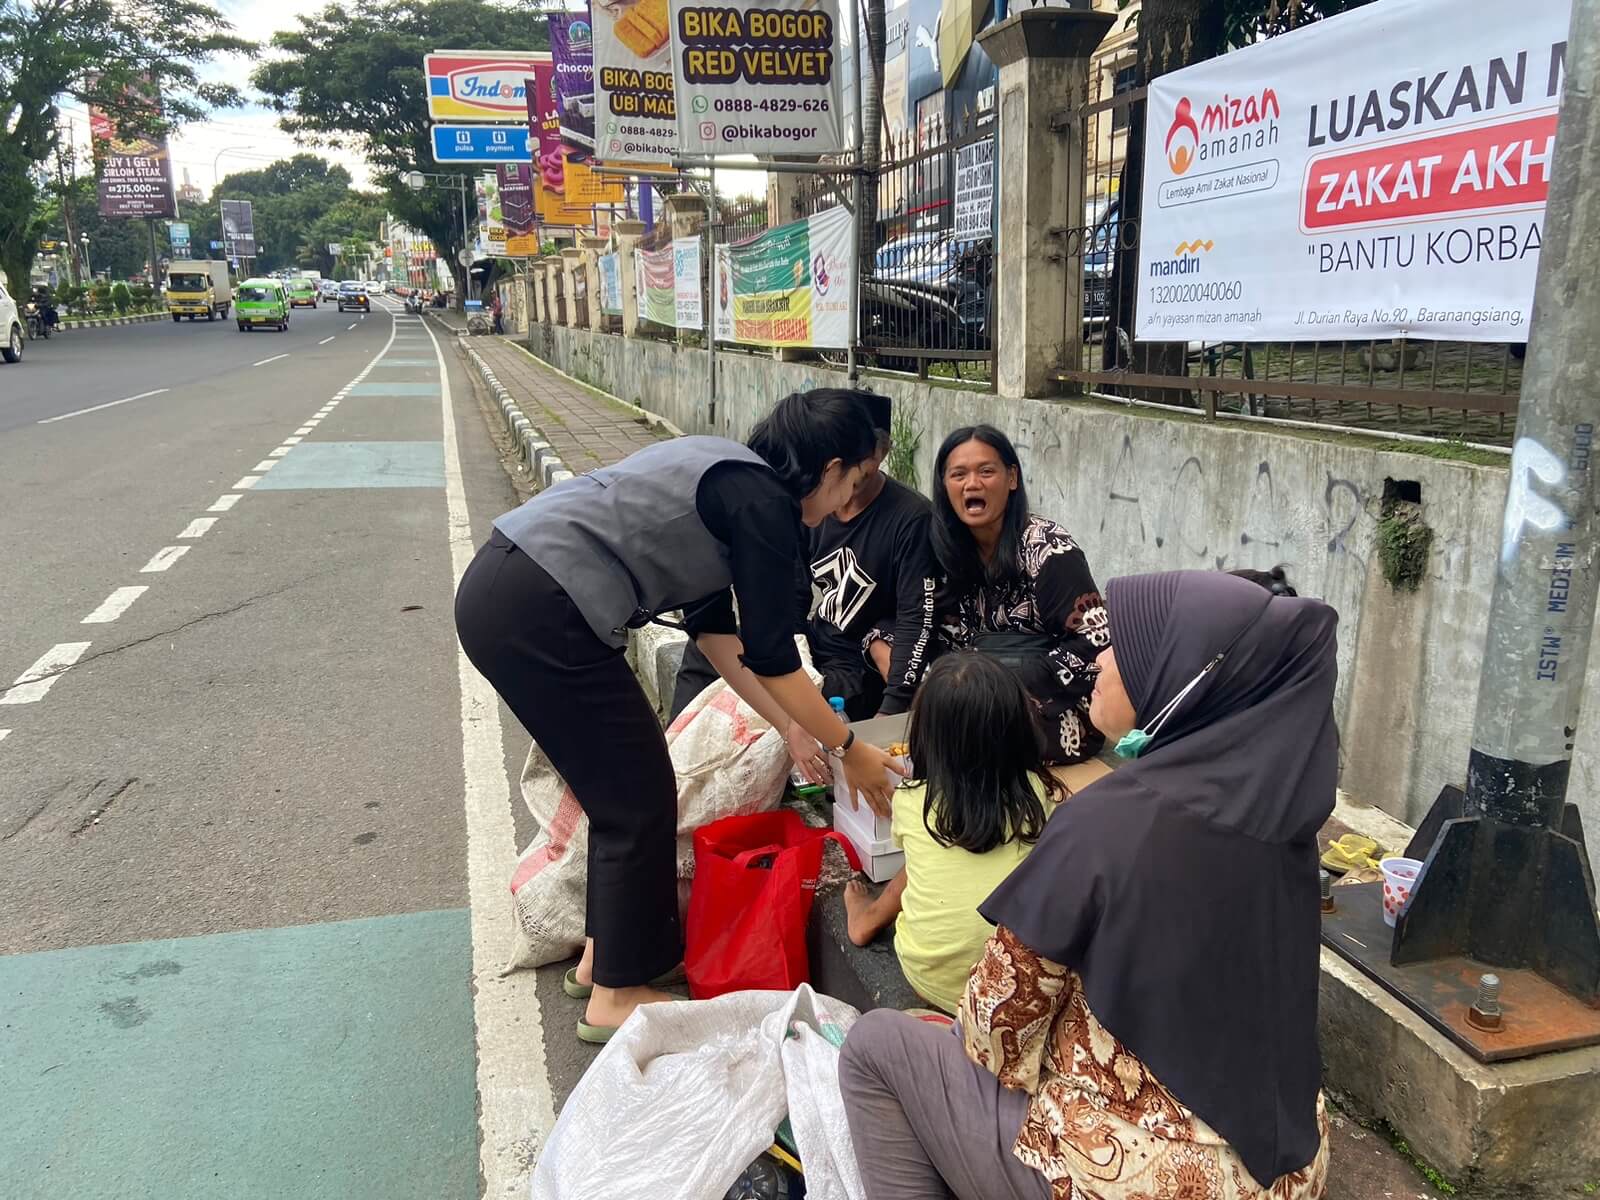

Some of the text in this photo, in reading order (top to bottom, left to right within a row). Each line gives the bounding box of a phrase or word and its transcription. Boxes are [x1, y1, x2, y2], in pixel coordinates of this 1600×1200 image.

[684, 12, 828, 39] BIKA BOGOR
[689, 51, 829, 76] RED VELVET
[604, 70, 640, 88] BIKA
[613, 95, 639, 111] UBI
[714, 99, 829, 112] 0888-4829-626
[1201, 88, 1280, 133] mizan
[1308, 51, 1527, 147] LUASKAN
[722, 124, 817, 142] @bikabogor
[1200, 120, 1278, 160] amanah
[1166, 169, 1269, 200] Lembaga Amil Zakat Nasional
[1316, 136, 1555, 213] ZAKAT AKH
[1426, 222, 1542, 265] KORBA
[1150, 253, 1200, 277] mandiri
[1150, 280, 1242, 304] 1320020040060
[1163, 313, 1194, 328] yayasan
[1196, 311, 1221, 323] mizan
[1224, 307, 1262, 324] amanah
[1308, 311, 1341, 324] Durian
[1343, 309, 1368, 326] Raya
